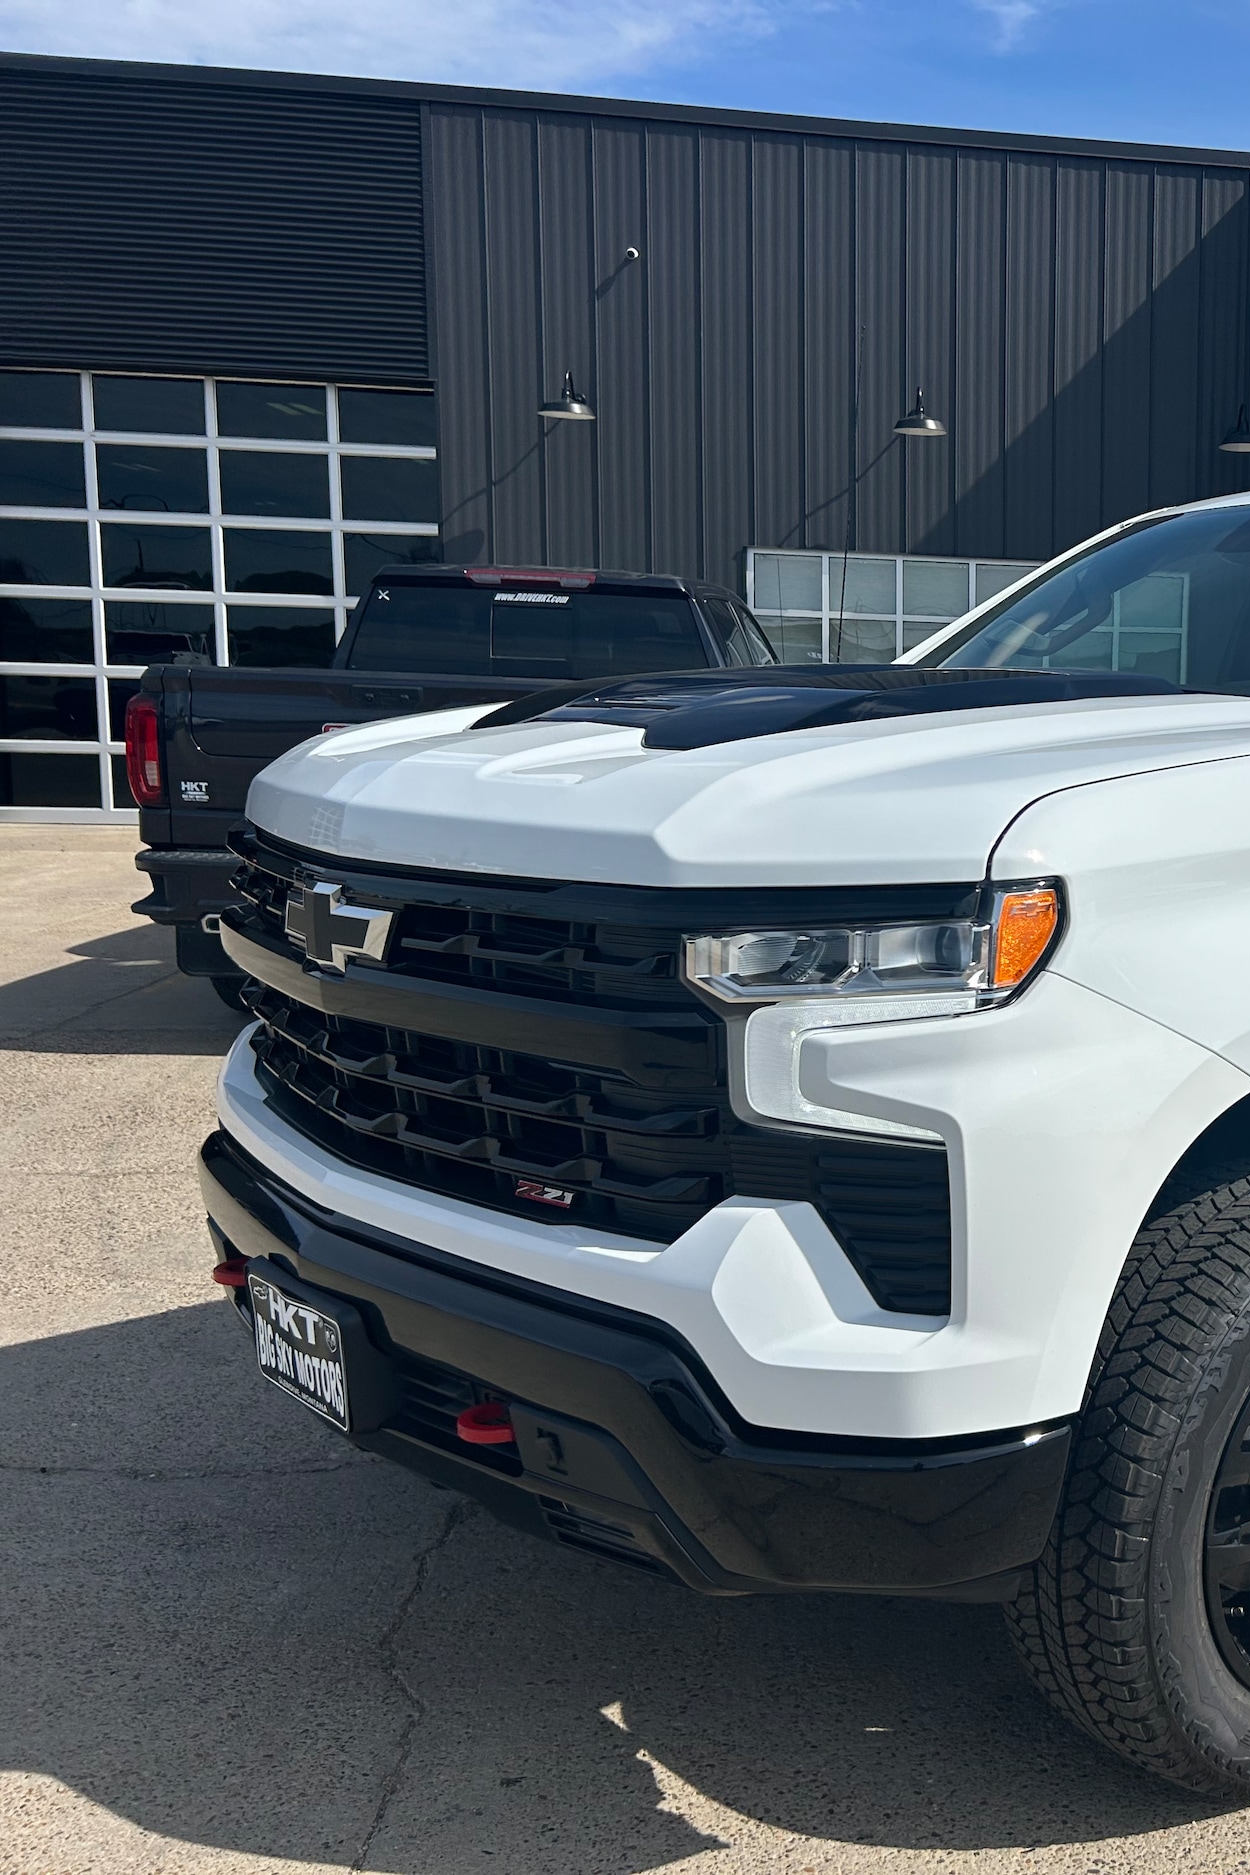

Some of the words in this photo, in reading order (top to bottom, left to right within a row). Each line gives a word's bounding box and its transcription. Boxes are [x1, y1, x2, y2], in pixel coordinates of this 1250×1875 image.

[180, 781, 209, 792] HKT
[515, 1179, 575, 1209] Z71
[268, 1287, 320, 1346] HKT
[256, 1312, 277, 1369] BIG
[275, 1332, 296, 1380] SKY
[294, 1348, 345, 1418] MOTORS
